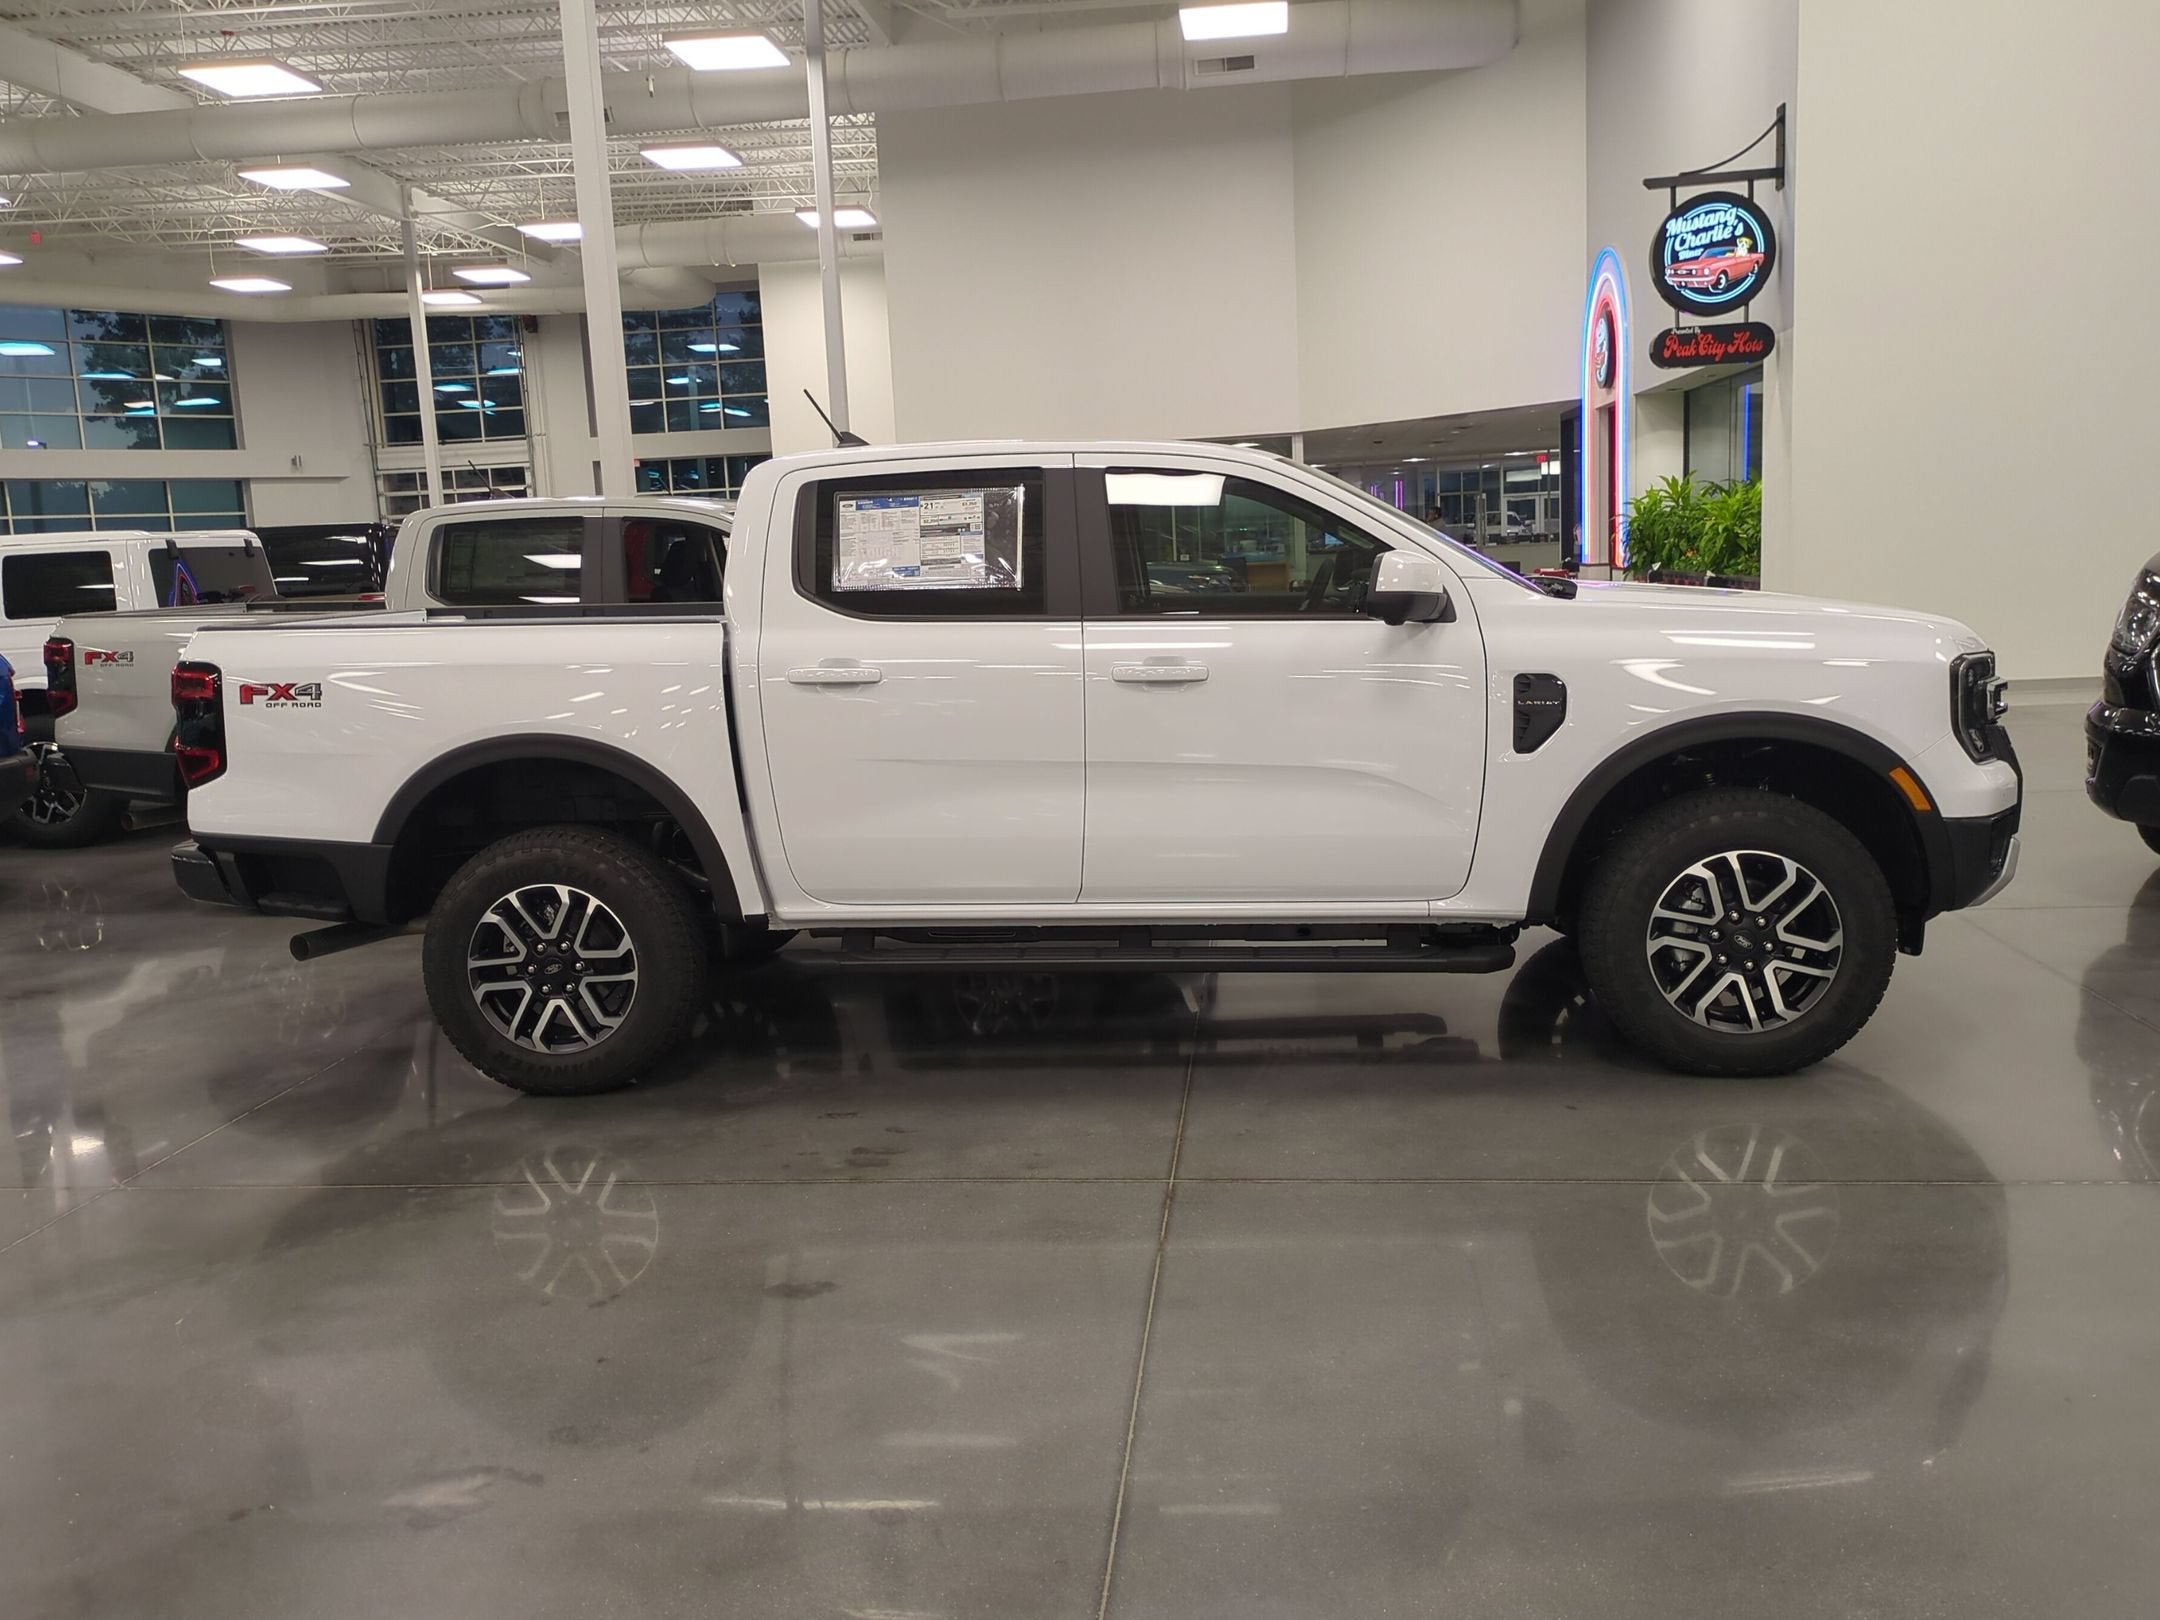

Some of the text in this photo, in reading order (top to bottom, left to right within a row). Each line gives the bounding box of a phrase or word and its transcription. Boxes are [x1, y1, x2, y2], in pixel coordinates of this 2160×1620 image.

[1666, 207, 1737, 237] Mustang
[1674, 219, 1744, 251] Charlie's
[1663, 335, 1697, 358] Peak
[1697, 333, 1726, 361] City
[84, 651, 134, 665] FX4
[239, 682, 322, 705] FX4
